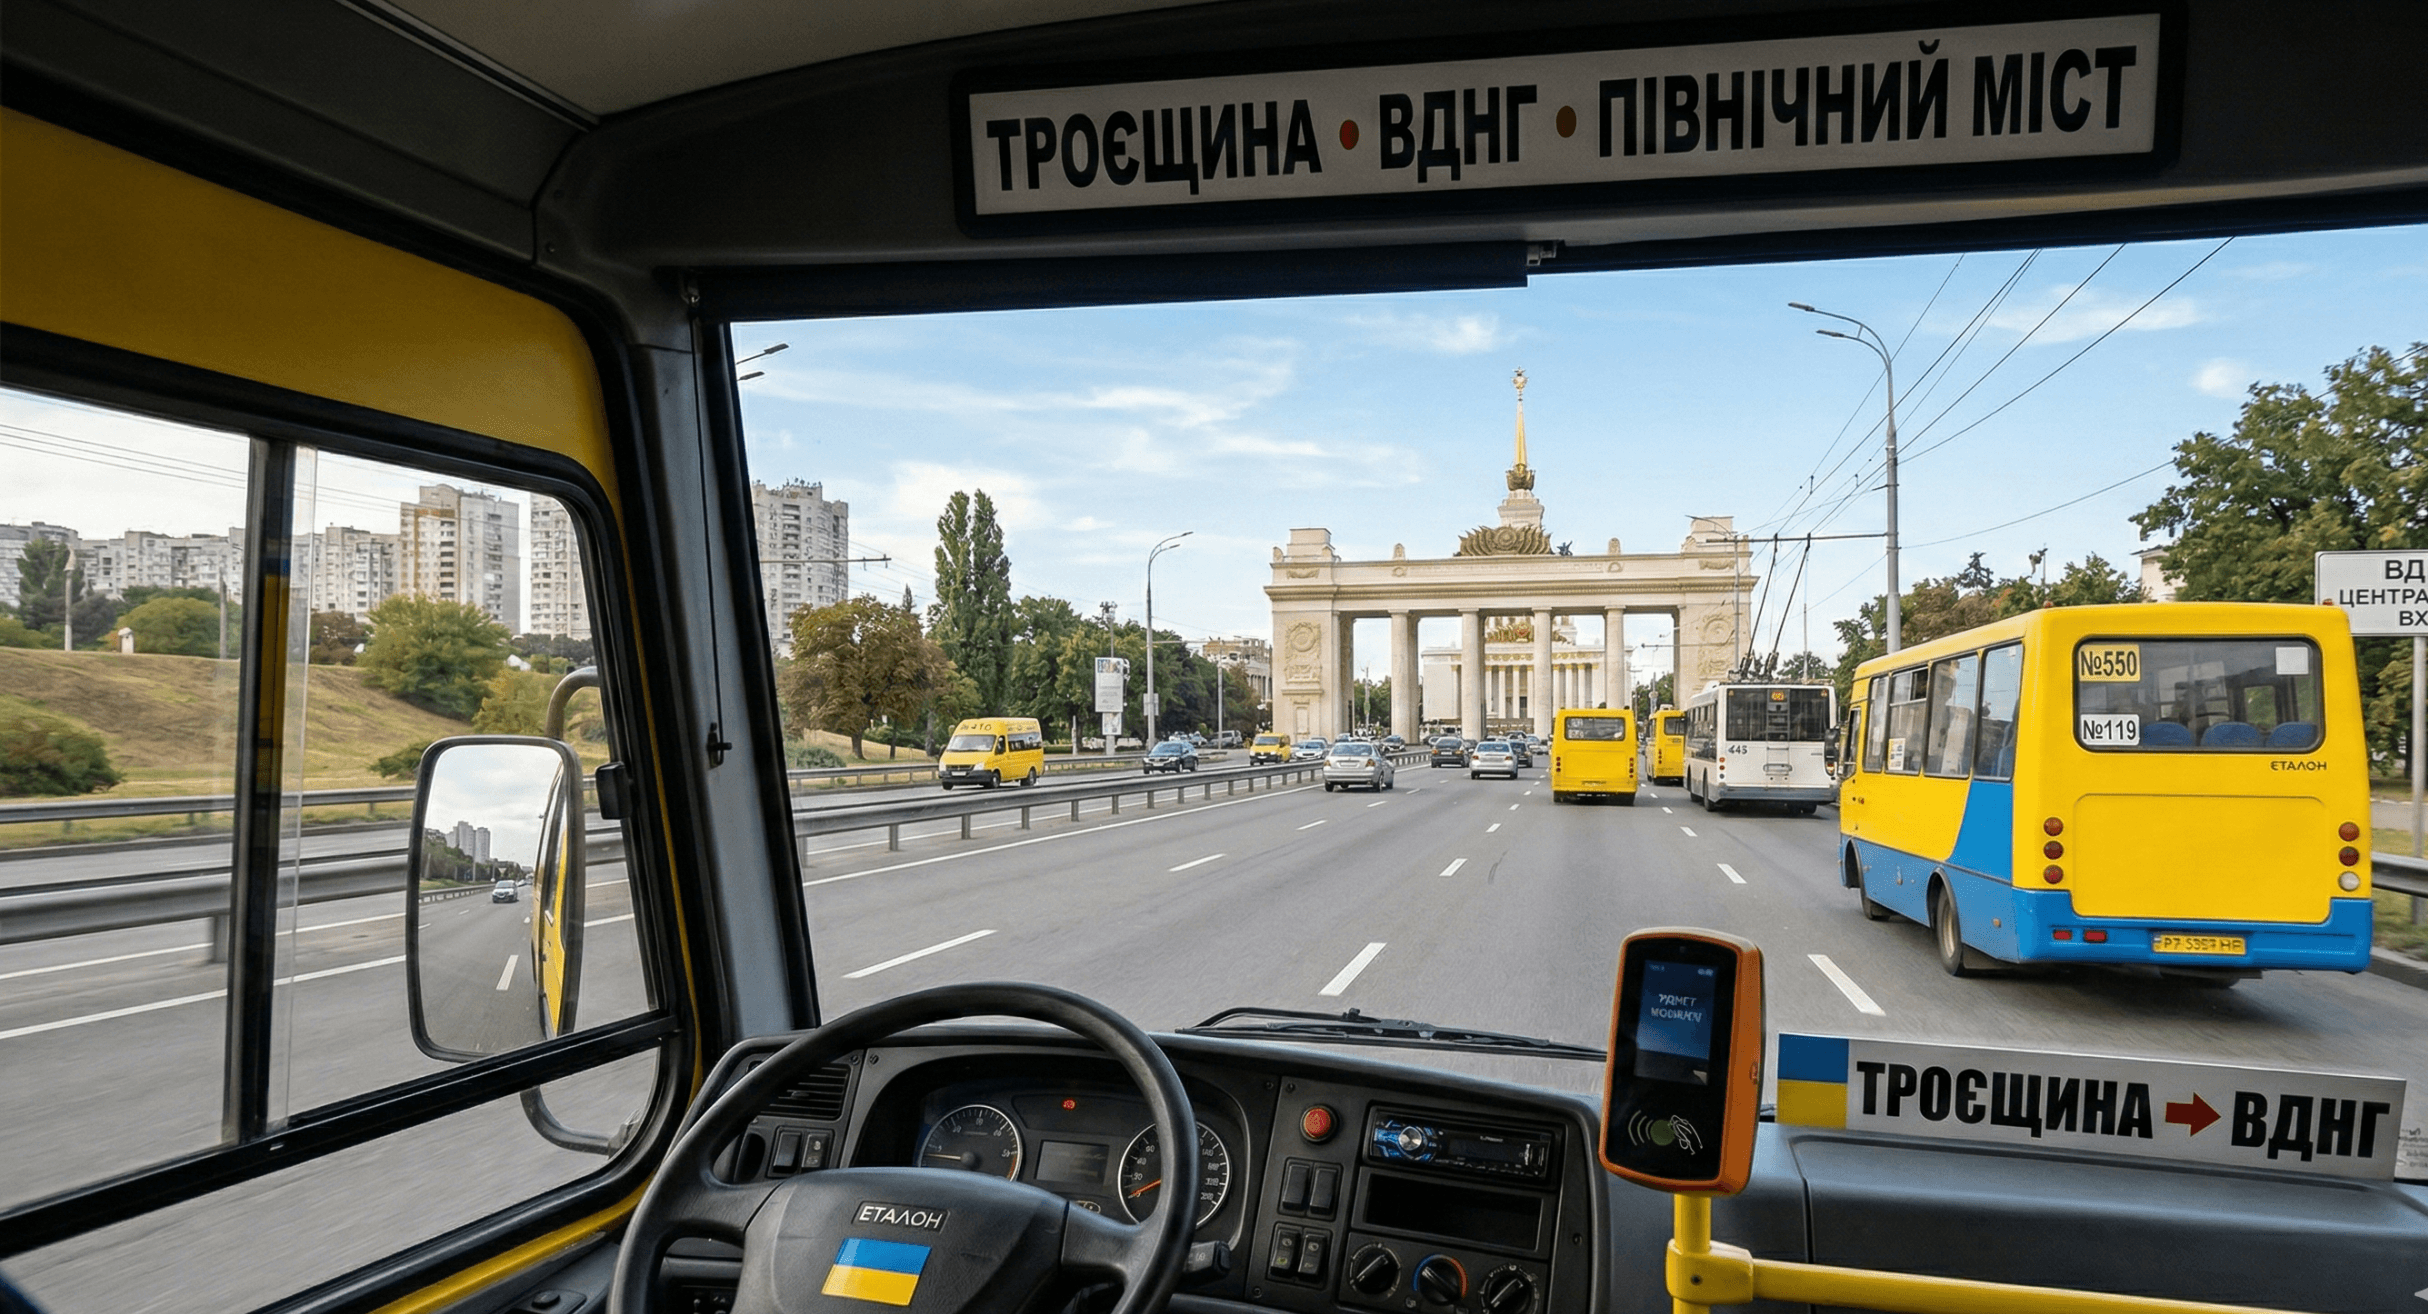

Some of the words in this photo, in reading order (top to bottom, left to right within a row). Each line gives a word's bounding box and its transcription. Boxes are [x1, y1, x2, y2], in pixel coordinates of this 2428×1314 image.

[986, 99, 1322, 195] ТРОЄЩИНА
[1379, 85, 1537, 183] ВДНГ
[1599, 39, 1949, 158] ПІВНІЧНИЙ
[1973, 45, 2137, 136] МІСТ
[2385, 559, 2426, 584] ВД
[2340, 588, 2428, 608] ЦЕНТРА
[2399, 610, 2428, 627] ВХ
[2080, 651, 2137, 676] №550
[2083, 719, 2137, 741] №119
[1856, 1061, 2153, 1139] ТРОЄЩИНА
[2231, 1091, 2391, 1162] ВДНГ
[858, 1205, 943, 1229] ЕТАЛОН
